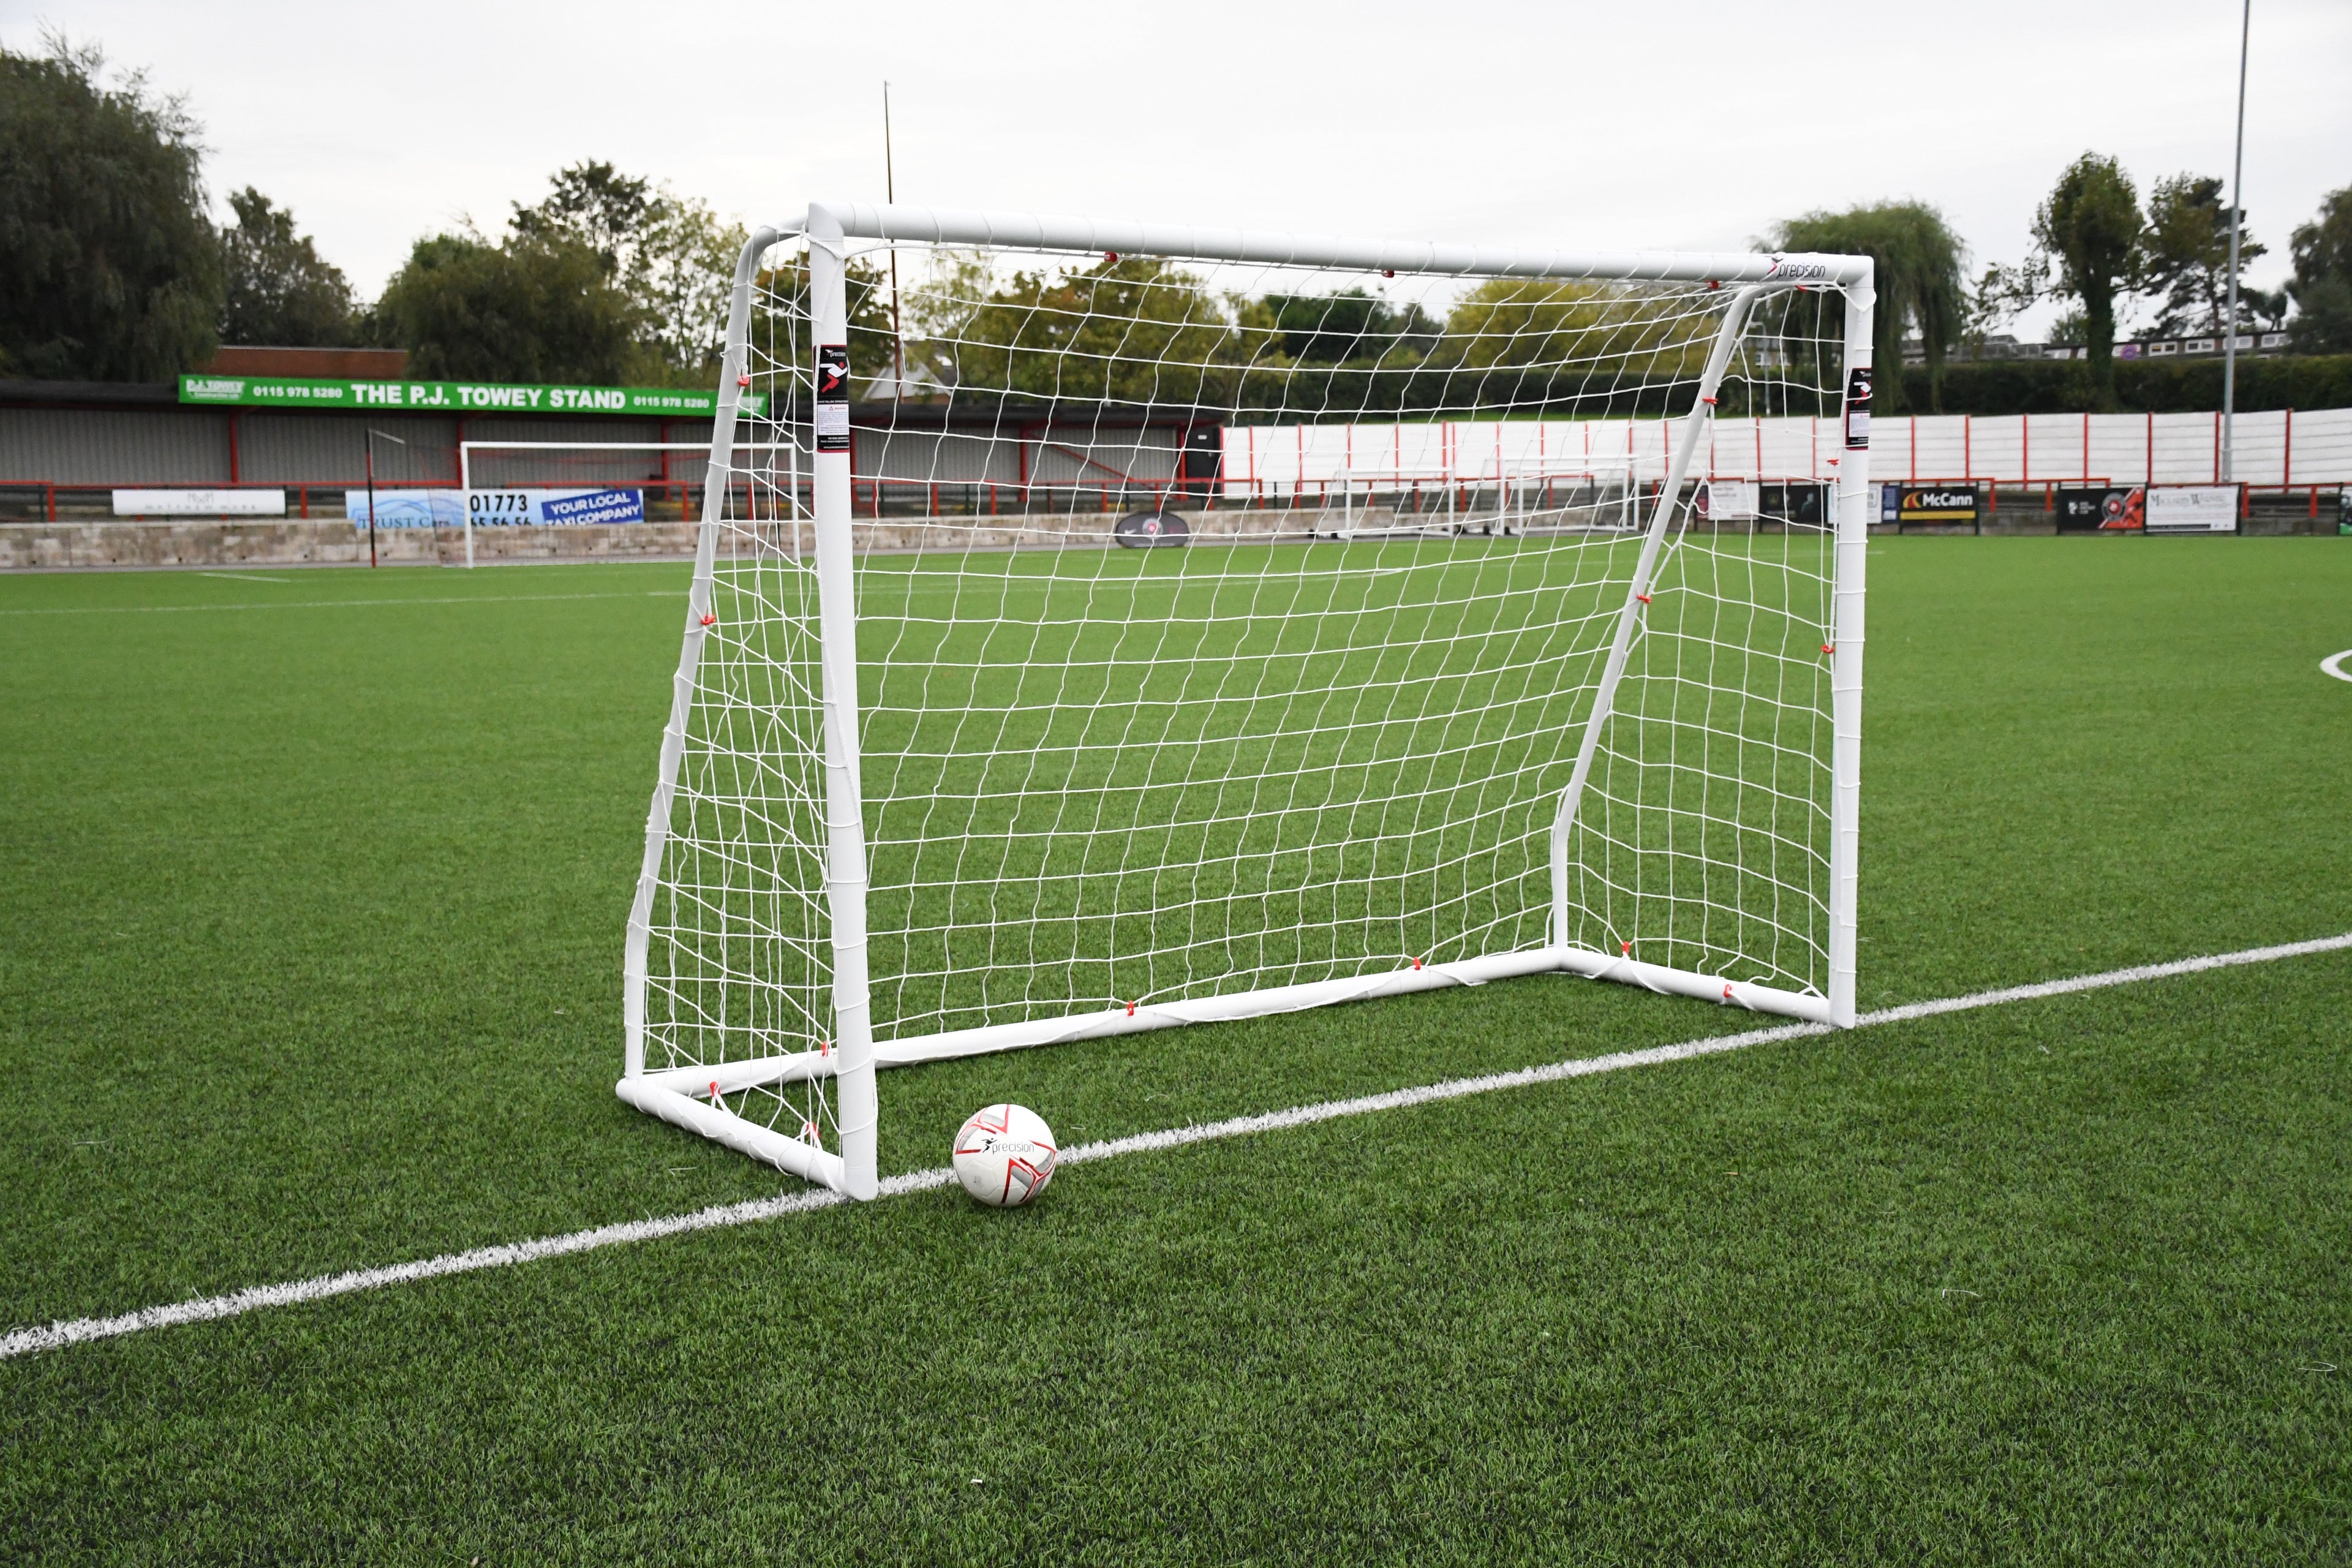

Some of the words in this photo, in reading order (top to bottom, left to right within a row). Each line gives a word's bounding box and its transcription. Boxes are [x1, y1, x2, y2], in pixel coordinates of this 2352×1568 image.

[1776, 262, 1825, 279] precision
[253, 386, 284, 397] 0115
[287, 386, 310, 398] 978
[350, 384, 402, 404] THE
[410, 385, 450, 405] P.J.
[458, 386, 542, 407] TOWEY
[549, 388, 626, 409] STAND
[634, 396, 660, 407] 0115
[470, 494, 527, 512] 01773
[551, 499, 588, 515] YOUR
[588, 492, 631, 509] LOCAL
[1922, 492, 1973, 507] McCann
[576, 504, 639, 526] COMPANY
[992, 1142, 1034, 1155] precision
